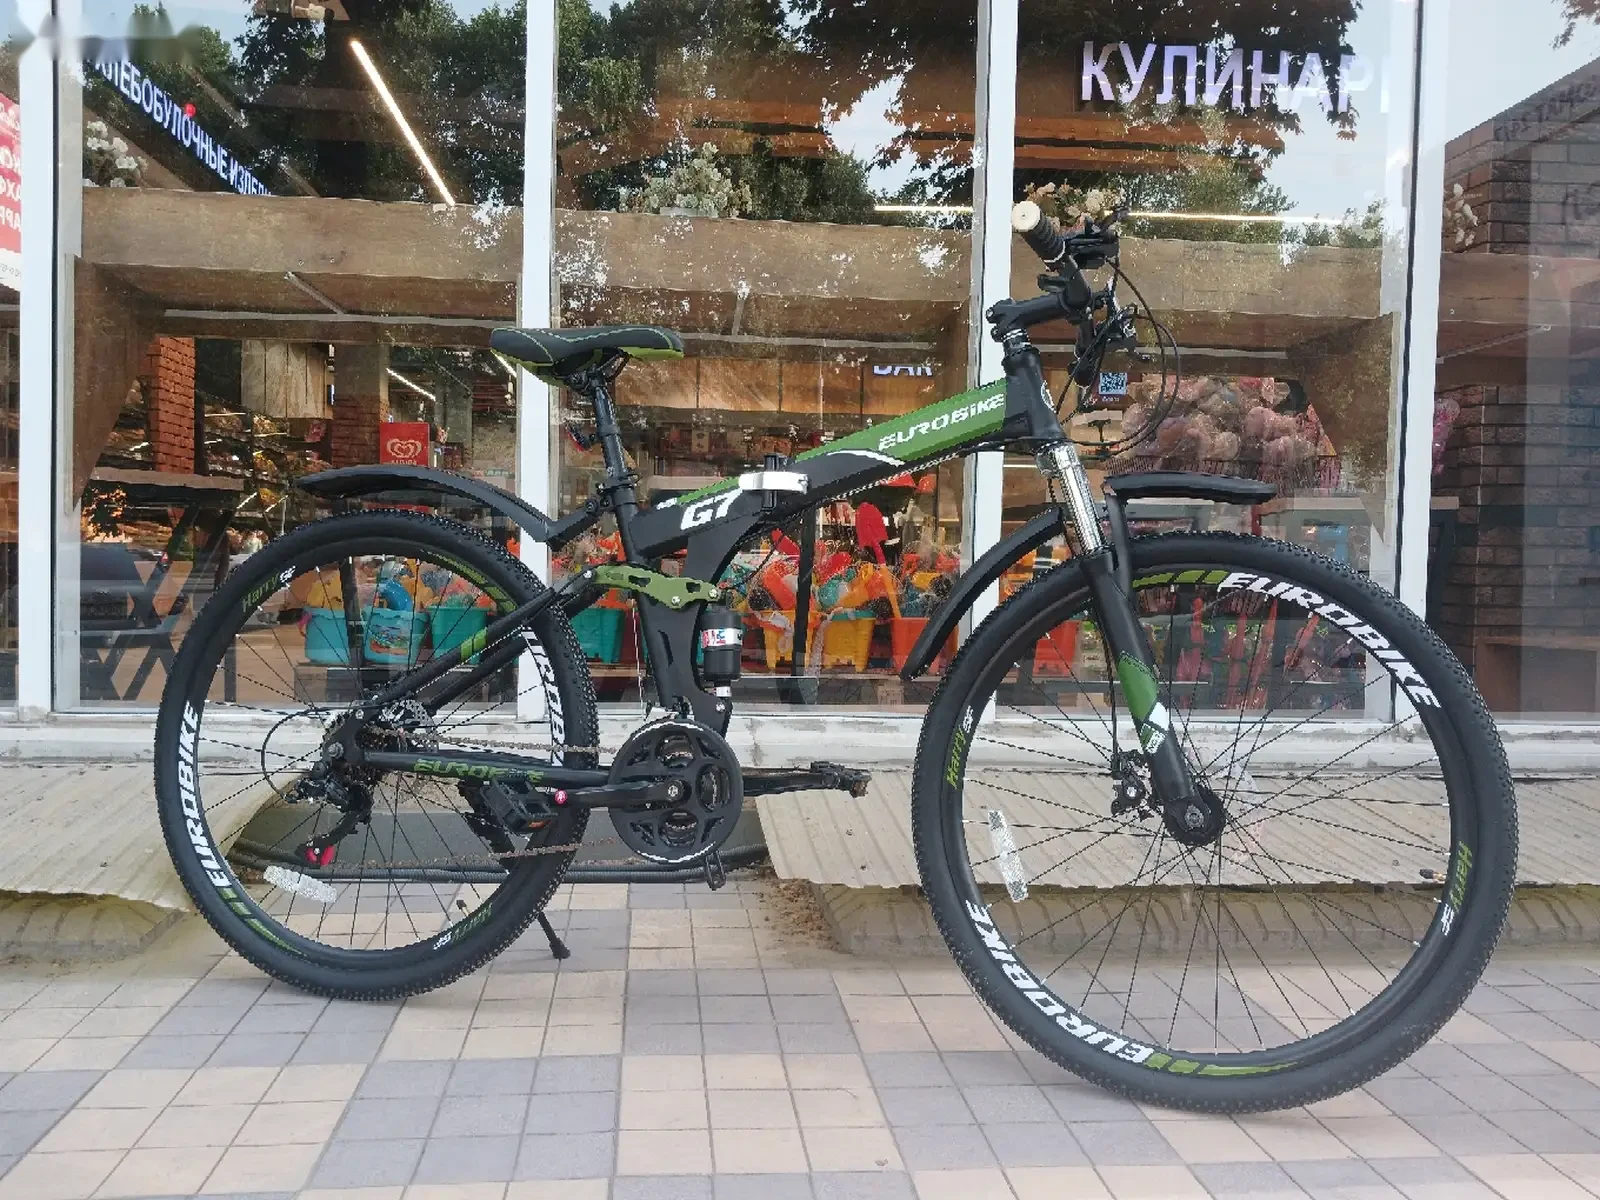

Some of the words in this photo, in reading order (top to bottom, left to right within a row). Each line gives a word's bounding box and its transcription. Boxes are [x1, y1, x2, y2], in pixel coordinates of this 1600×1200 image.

[878, 393, 1004, 451] EUROBIKE
[1217, 572, 1442, 708] EUROBIKE
[178, 700, 232, 887] EUROBIKE
[965, 900, 1155, 1063] EUROBIKE
